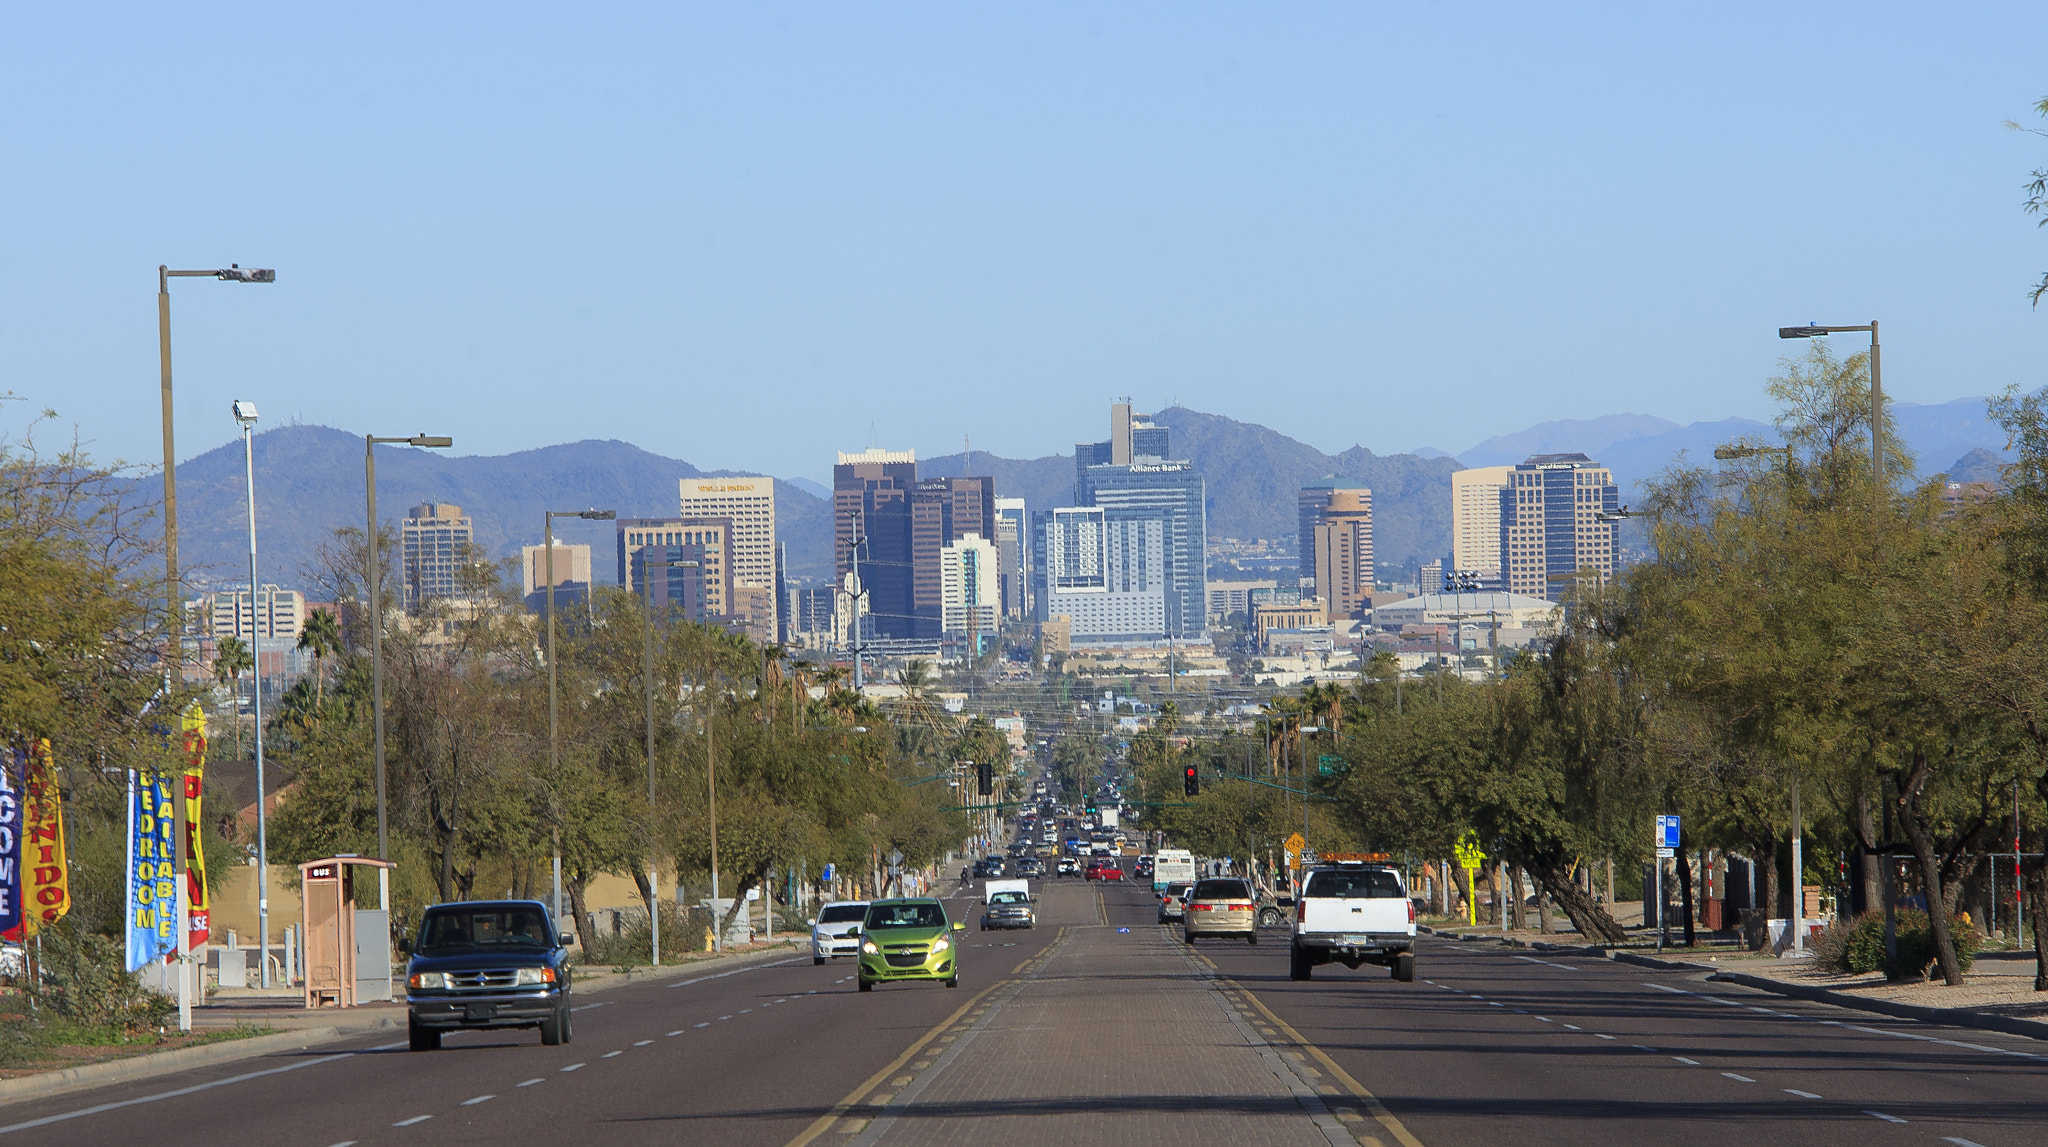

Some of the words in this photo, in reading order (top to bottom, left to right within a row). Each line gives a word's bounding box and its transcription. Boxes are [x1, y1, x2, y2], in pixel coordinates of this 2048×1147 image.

[1130, 464, 1160, 472] Alliance
[1161, 464, 1182, 472] Bank
[727, 484, 754, 492] FARGO
[0, 763, 15, 917] LCOME
[136, 768, 155, 929] BEDROOM
[313, 868, 330, 877] BUS
[188, 915, 208, 933] USE
